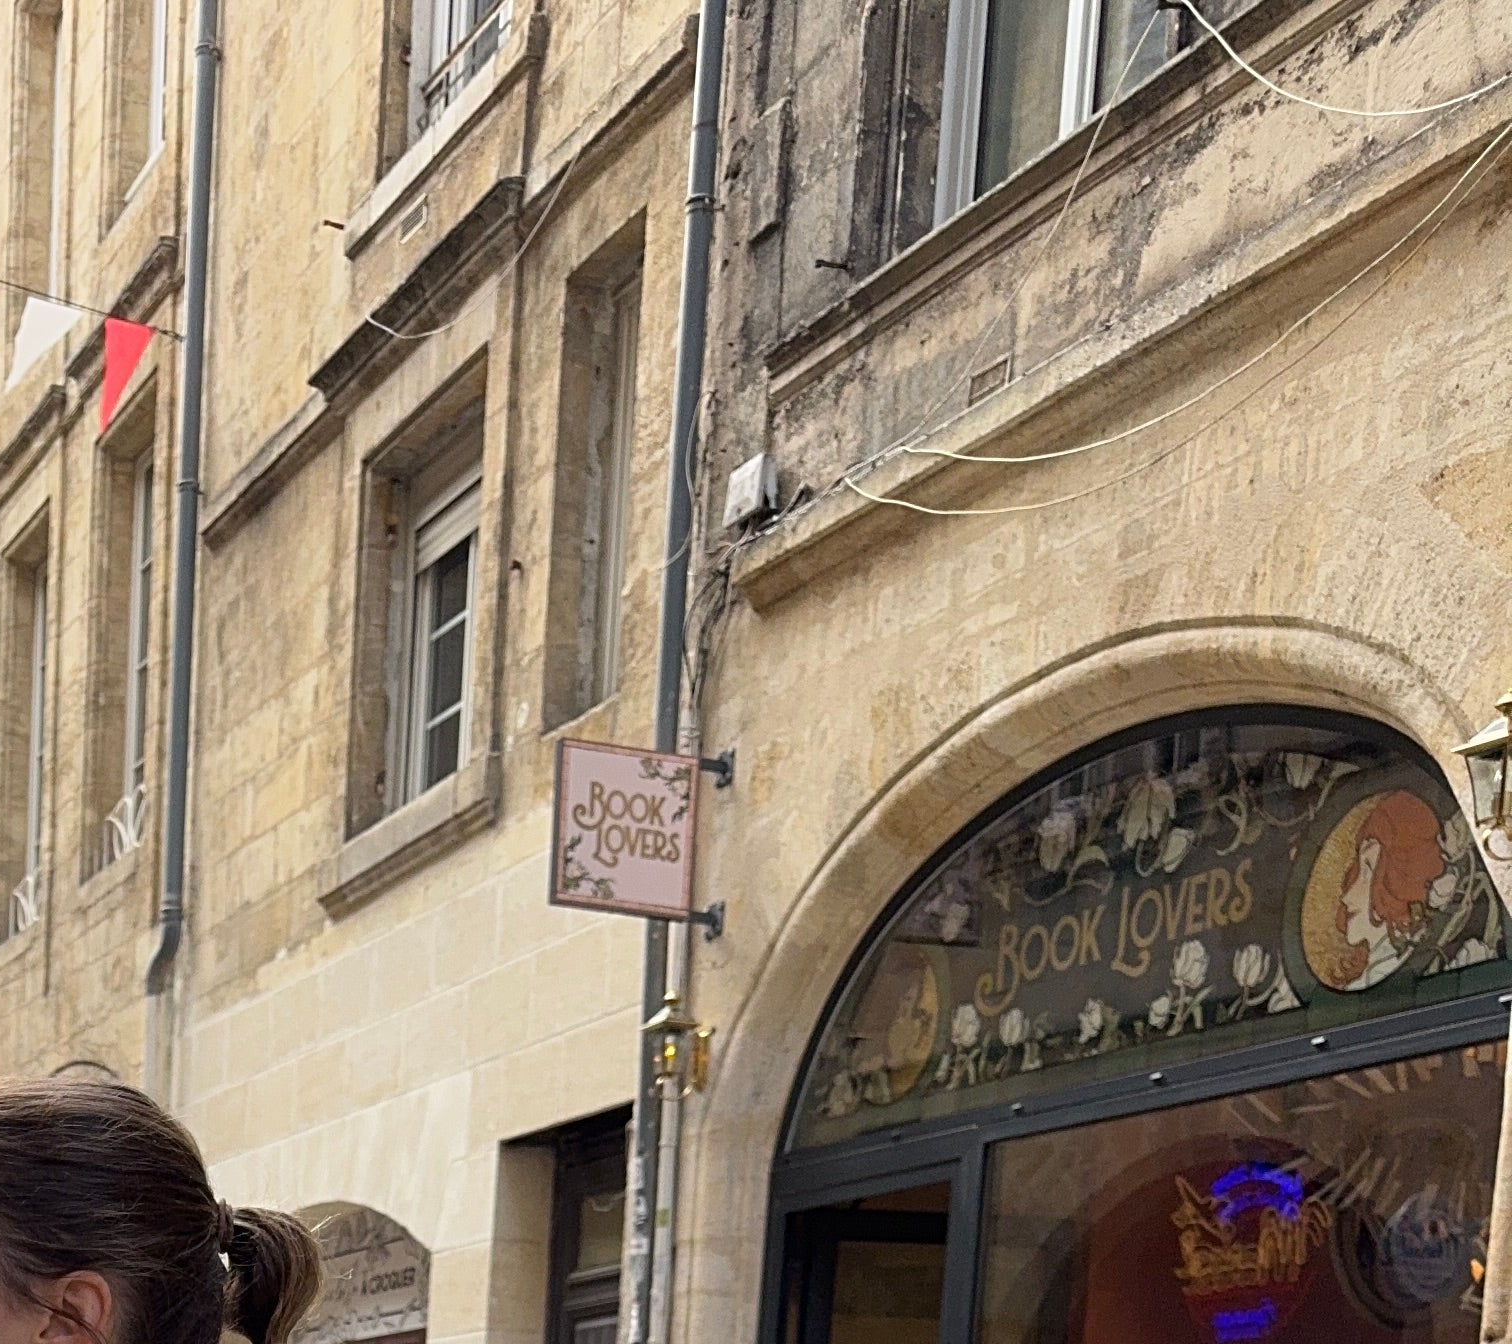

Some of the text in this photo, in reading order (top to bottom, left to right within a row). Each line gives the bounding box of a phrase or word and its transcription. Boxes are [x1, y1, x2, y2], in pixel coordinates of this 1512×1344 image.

[572, 780, 666, 831] BOOK
[593, 824, 680, 868] LOVERS
[974, 856, 1253, 1017] BOOK LOVERS
